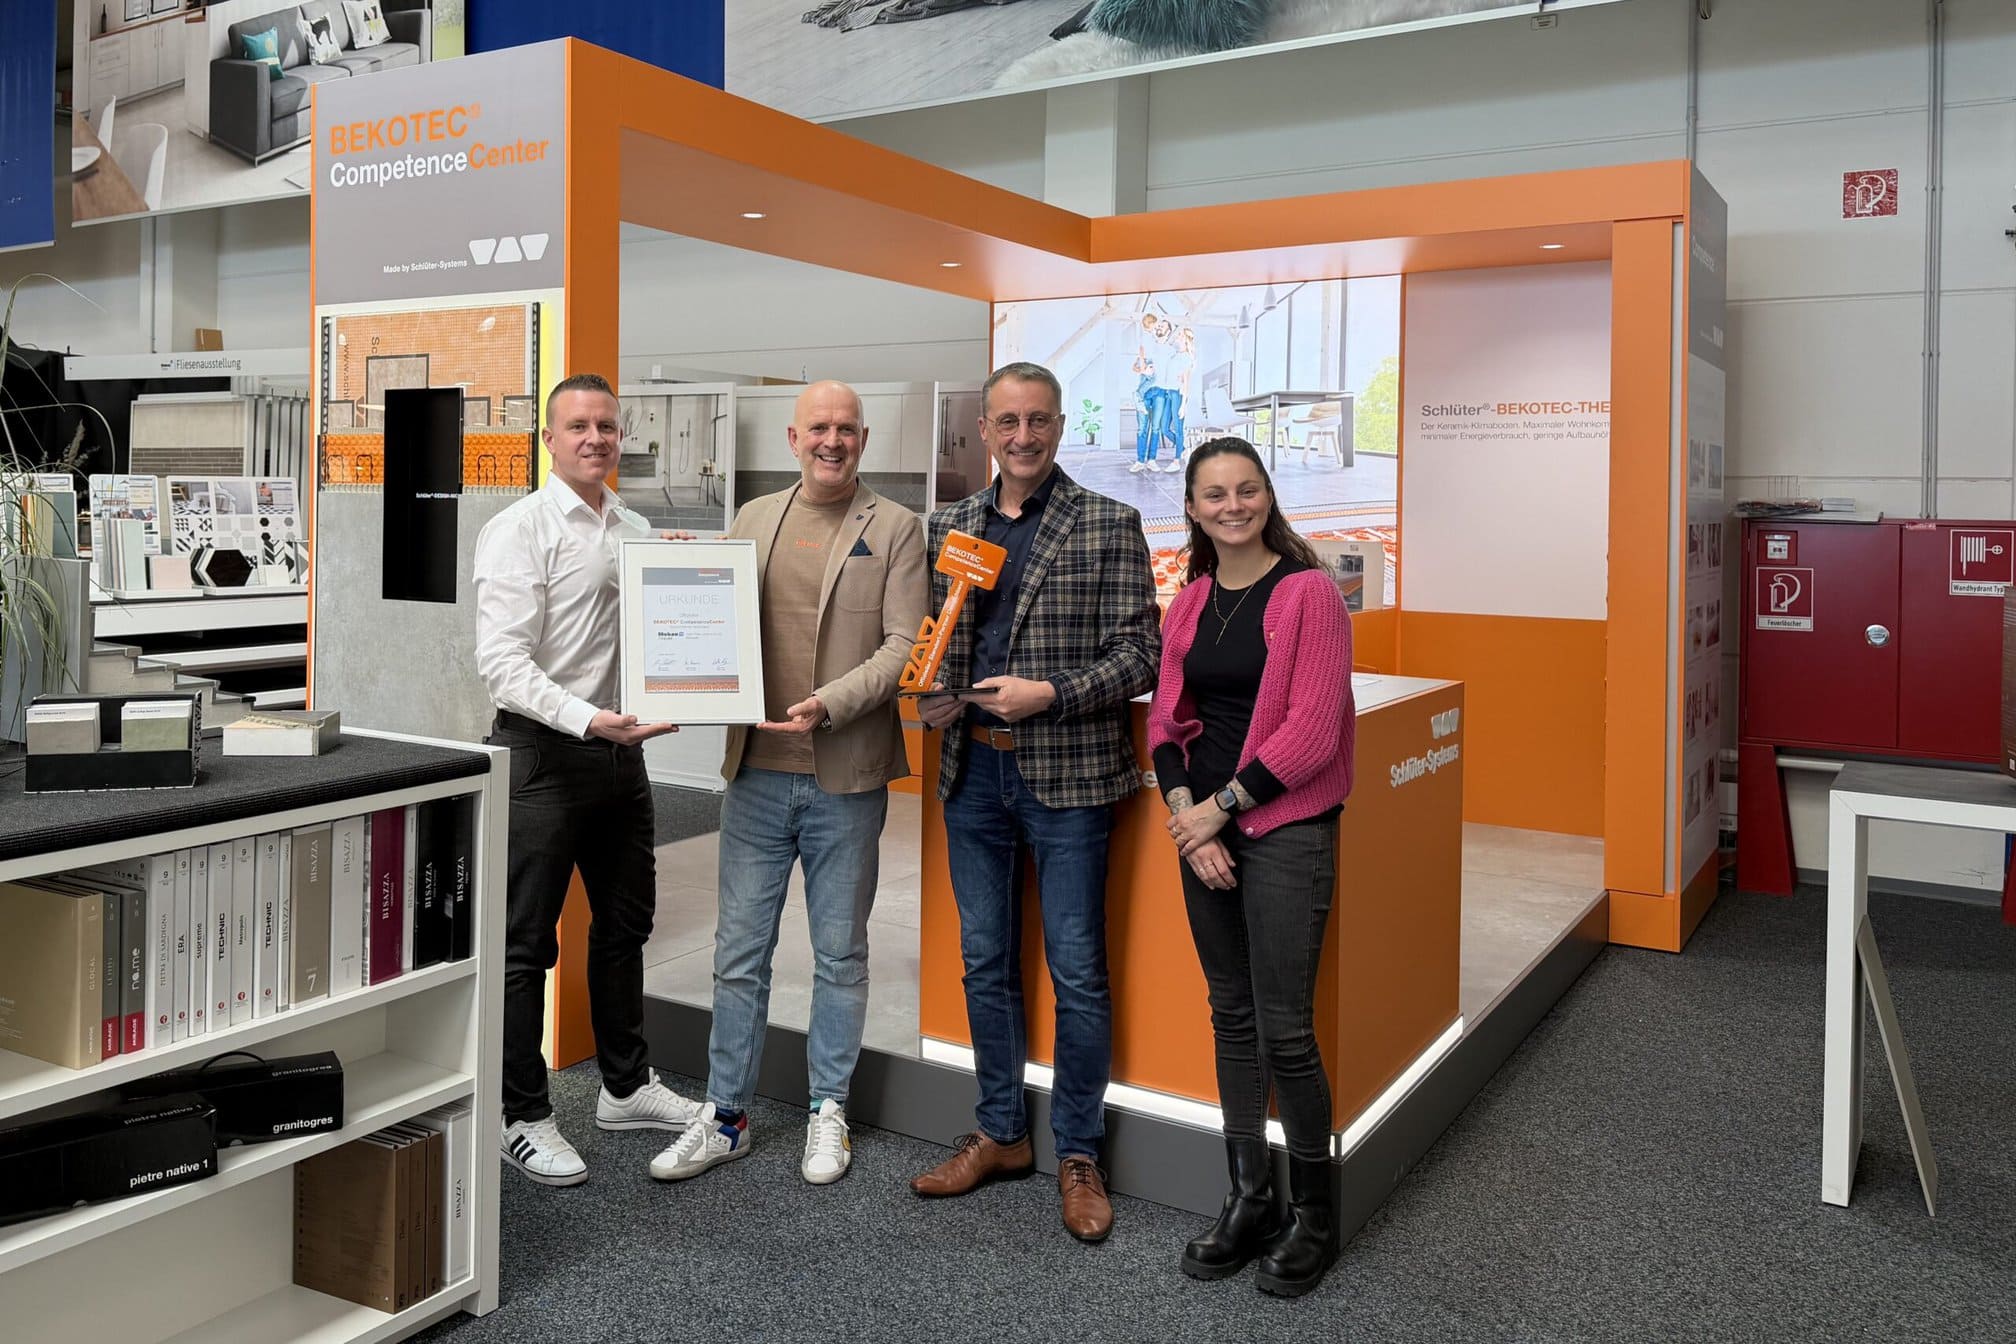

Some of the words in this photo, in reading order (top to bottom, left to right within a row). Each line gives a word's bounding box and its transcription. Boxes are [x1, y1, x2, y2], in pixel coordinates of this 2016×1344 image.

[330, 139, 549, 188] CompetenceCenter
[384, 264, 400, 274] Made
[402, 263, 410, 272] by
[411, 259, 468, 271] Schlüter-Systems
[176, 357, 240, 370] Fliesenausstellung
[1421, 422, 1434, 430] Der
[1437, 421, 1520, 430] Keramik-Klimaboden.
[1523, 420, 1564, 429] Maximaler
[1421, 432, 1458, 440] minimaler
[1460, 431, 1530, 441] Energieverbrauch,
[1533, 432, 1564, 441] geringe
[1952, 584, 1993, 593] Wandhydrant
[660, 594, 720, 605] URKUNDE
[1767, 620, 1802, 628] Feuerlöscher
[1390, 744, 1458, 788] Schlüter-Systems
[310, 839, 318, 882] BISAZZA
[132, 947, 140, 990] na.me
[307, 973, 316, 992] 7
[272, 1065, 332, 1076] granitogres
[124, 1114, 158, 1124] pietre
[160, 1108, 194, 1117] native
[273, 1116, 333, 1134] granitogres
[130, 1172, 163, 1188] pietre
[166, 1164, 200, 1178] native
[203, 1159, 208, 1168] 1
